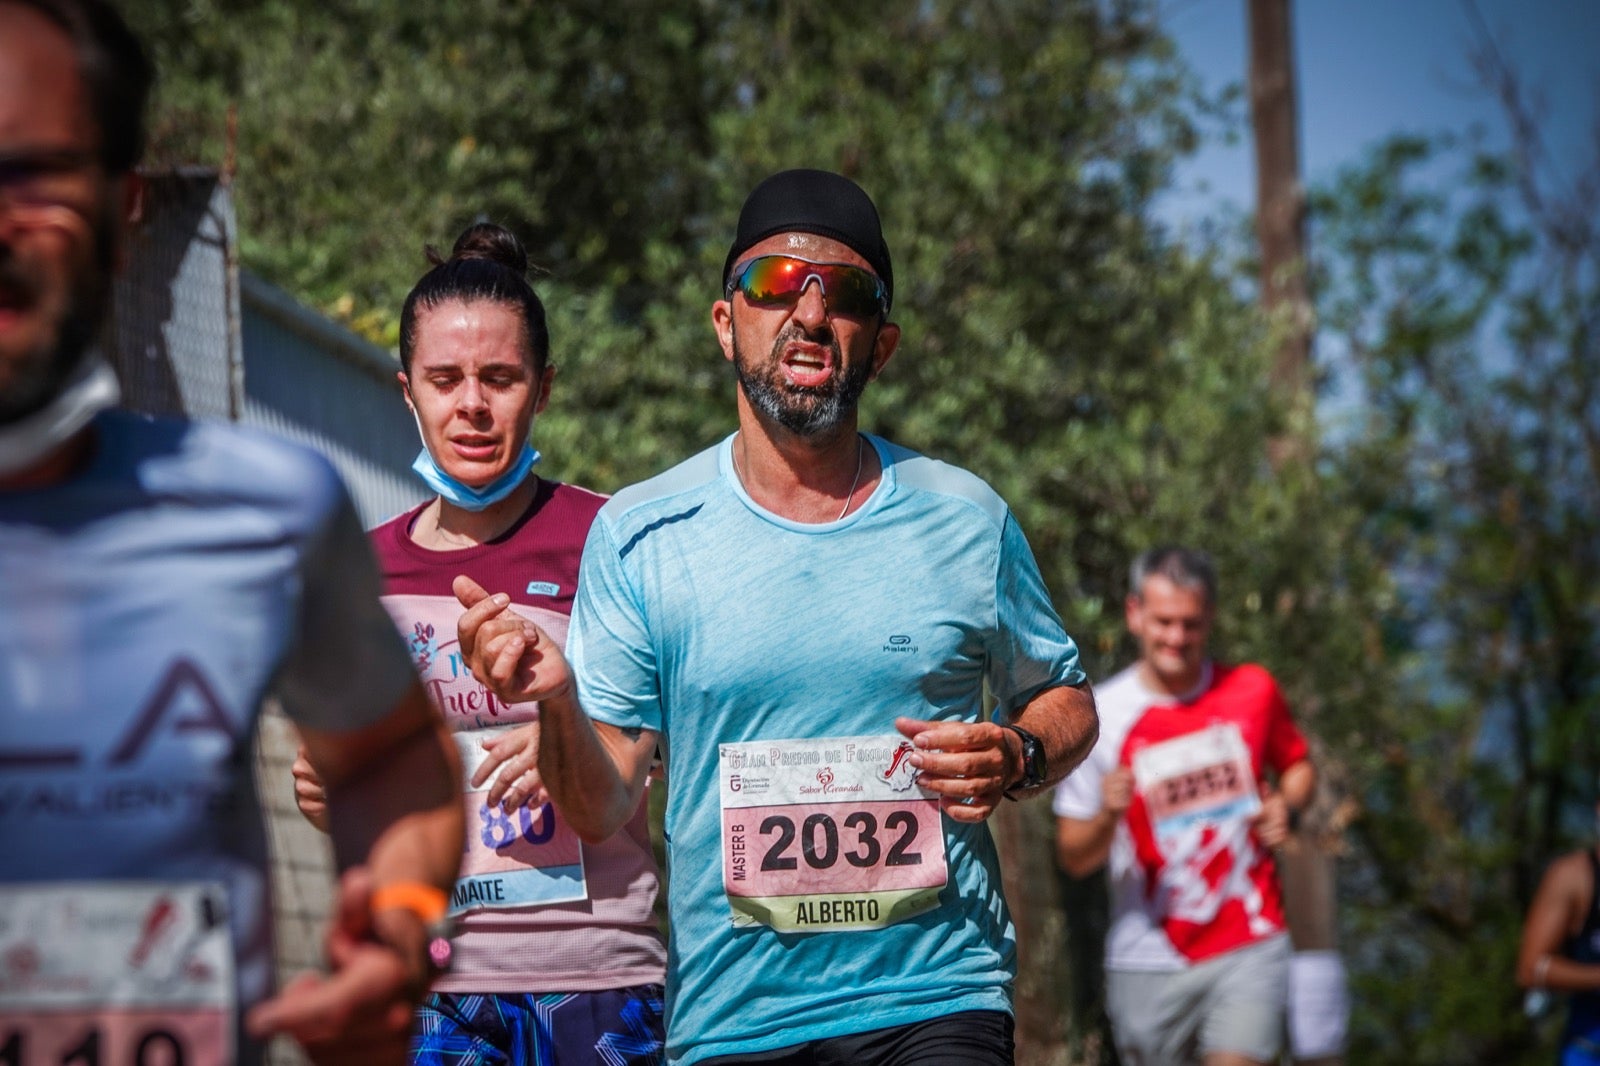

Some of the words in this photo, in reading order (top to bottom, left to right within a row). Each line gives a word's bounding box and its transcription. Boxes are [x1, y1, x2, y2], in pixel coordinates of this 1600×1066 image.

[731, 824, 745, 832] B
[759, 810, 922, 872] 2032
[731, 834, 746, 880] MASTER
[453, 878, 505, 908] MAITE
[796, 898, 879, 924] ALBERTO
